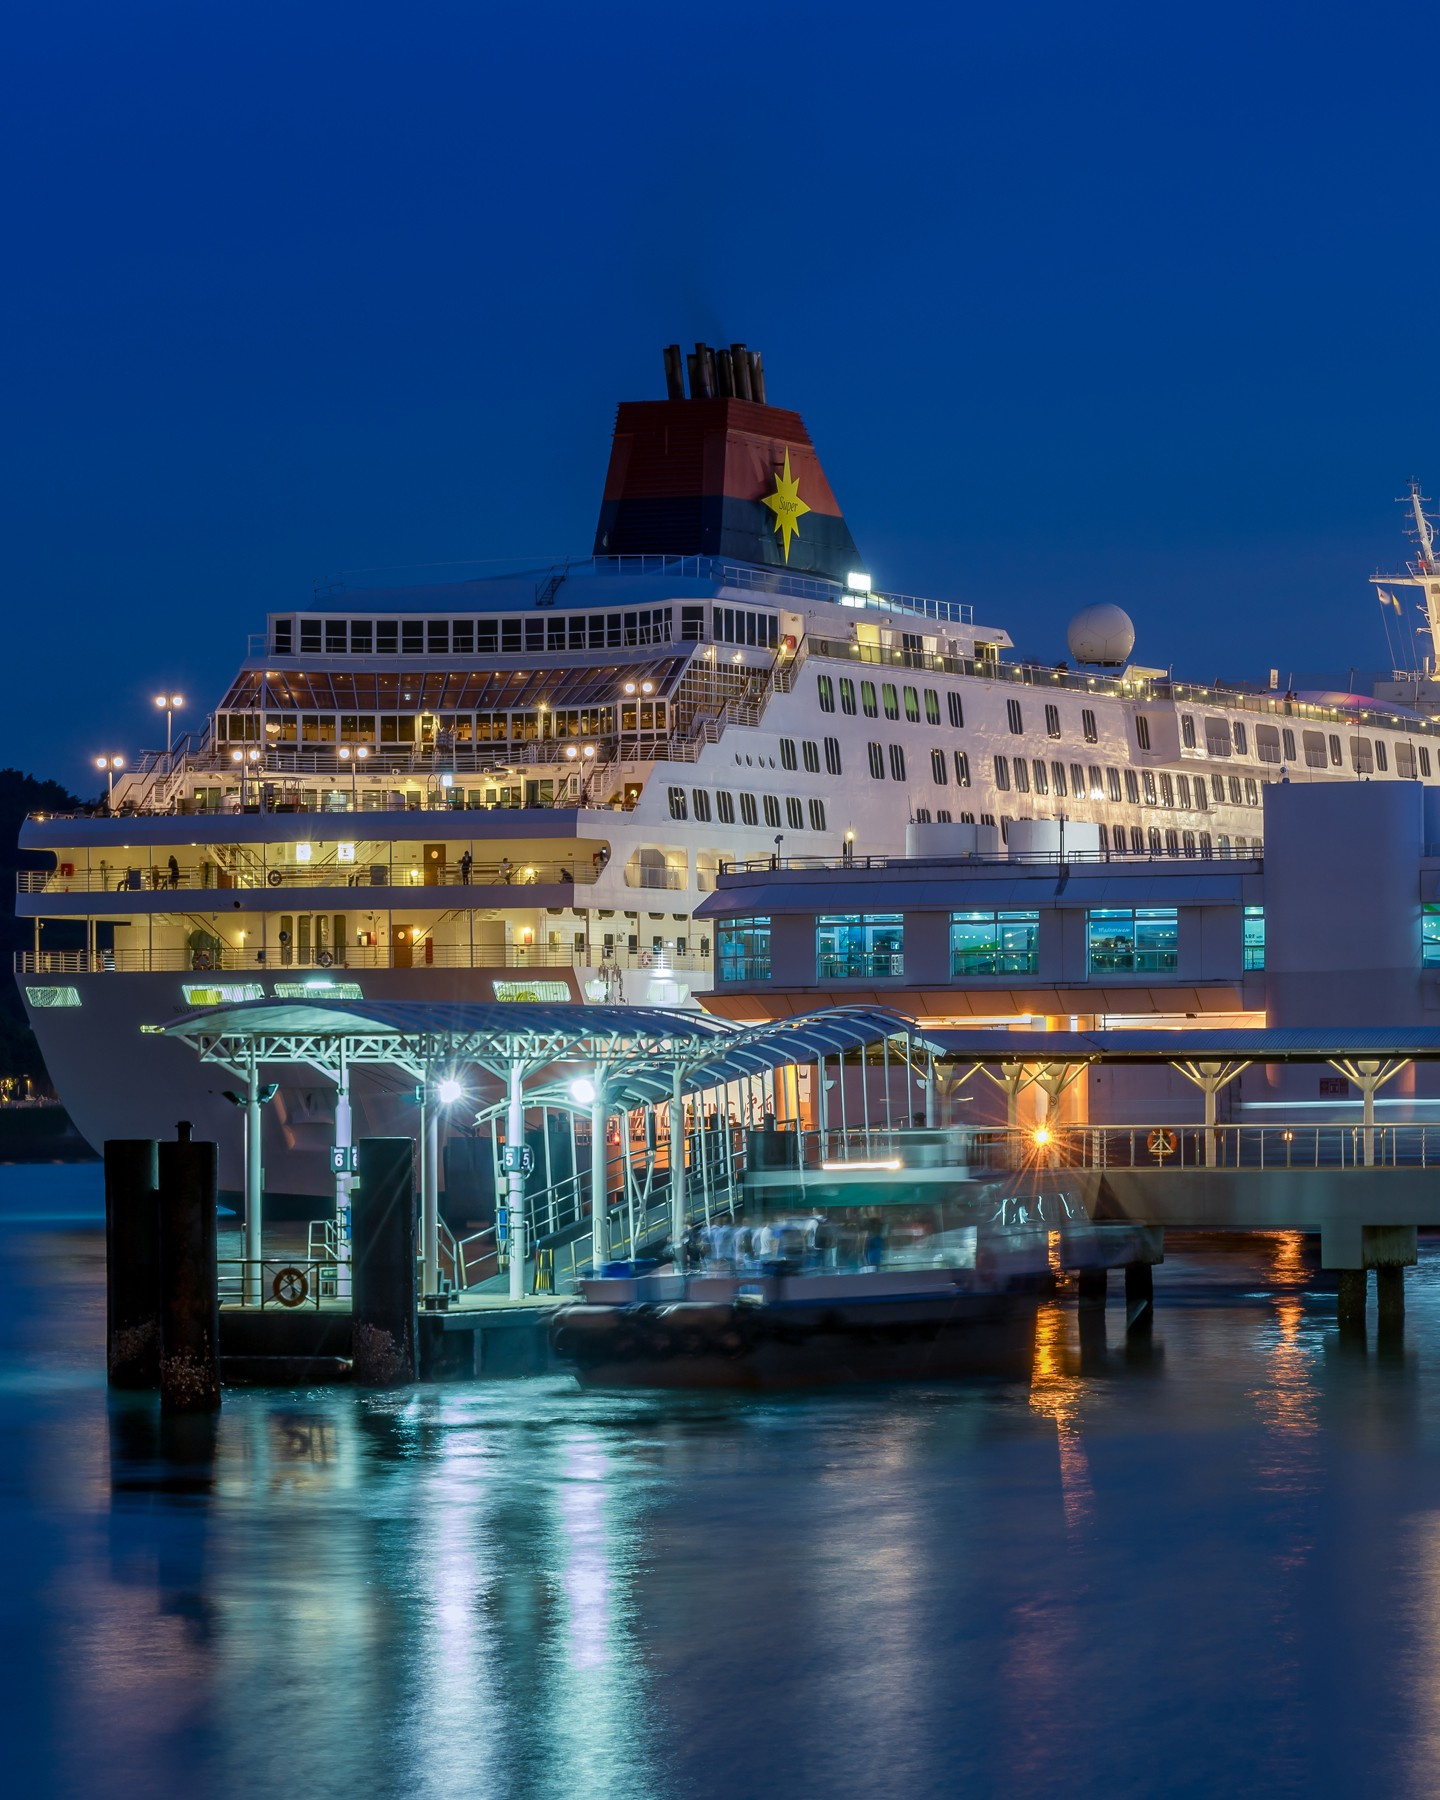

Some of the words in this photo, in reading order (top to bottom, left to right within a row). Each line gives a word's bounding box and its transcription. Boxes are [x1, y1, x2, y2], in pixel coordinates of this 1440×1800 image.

[334, 1153, 344, 1167] 6
[505, 1153, 514, 1166] 5
[522, 1153, 530, 1166] 5
